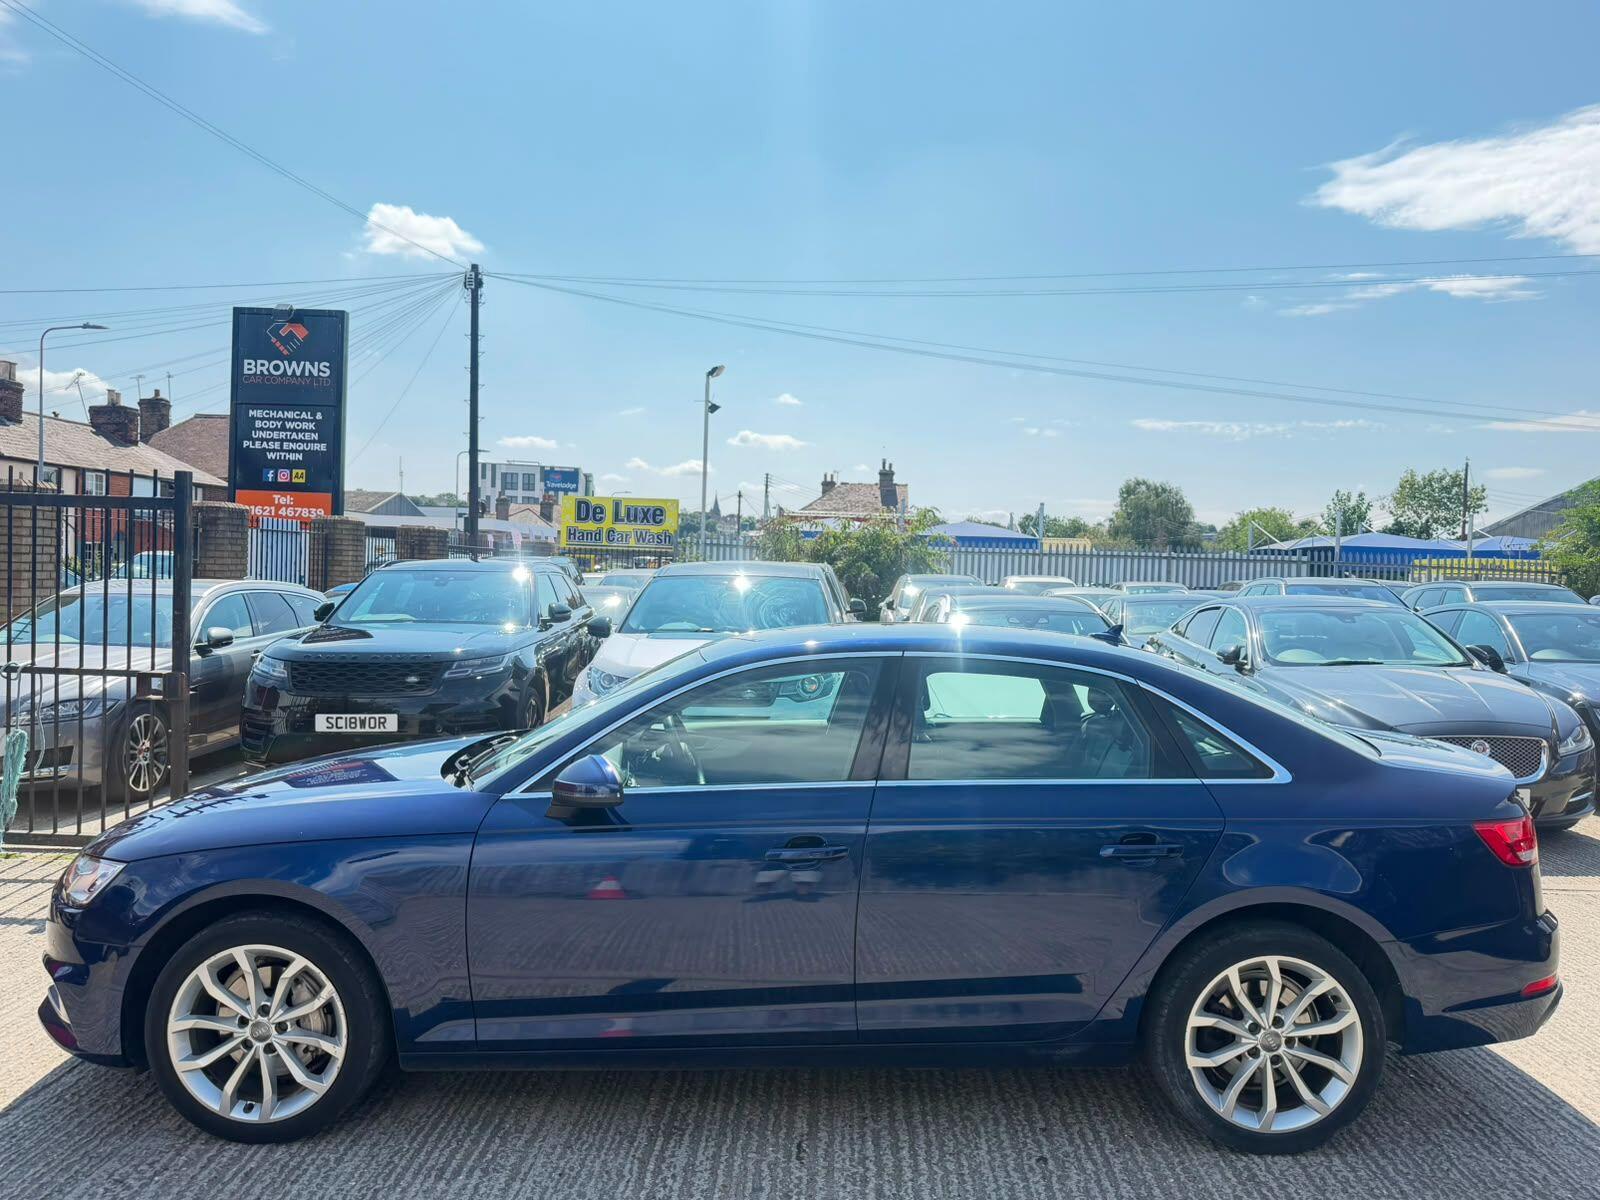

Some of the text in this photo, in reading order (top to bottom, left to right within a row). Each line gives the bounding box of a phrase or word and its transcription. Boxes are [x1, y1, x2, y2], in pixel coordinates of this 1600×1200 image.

[243, 359, 331, 377] BROWNS
[242, 375, 331, 387] CAR COMPANY LTD
[248, 409, 323, 420] MECHANICAL &
[255, 420, 316, 430] BODY WORK
[251, 430, 318, 440] UNDERTAKEN
[243, 440, 327, 451] PLEASE ENQUIRE
[266, 452, 303, 460] WITHIN
[272, 494, 294, 505] Tel:
[249, 505, 325, 517] 1621 467839
[575, 498, 666, 526] De Luxe
[567, 526, 673, 546] Hand Car Wash
